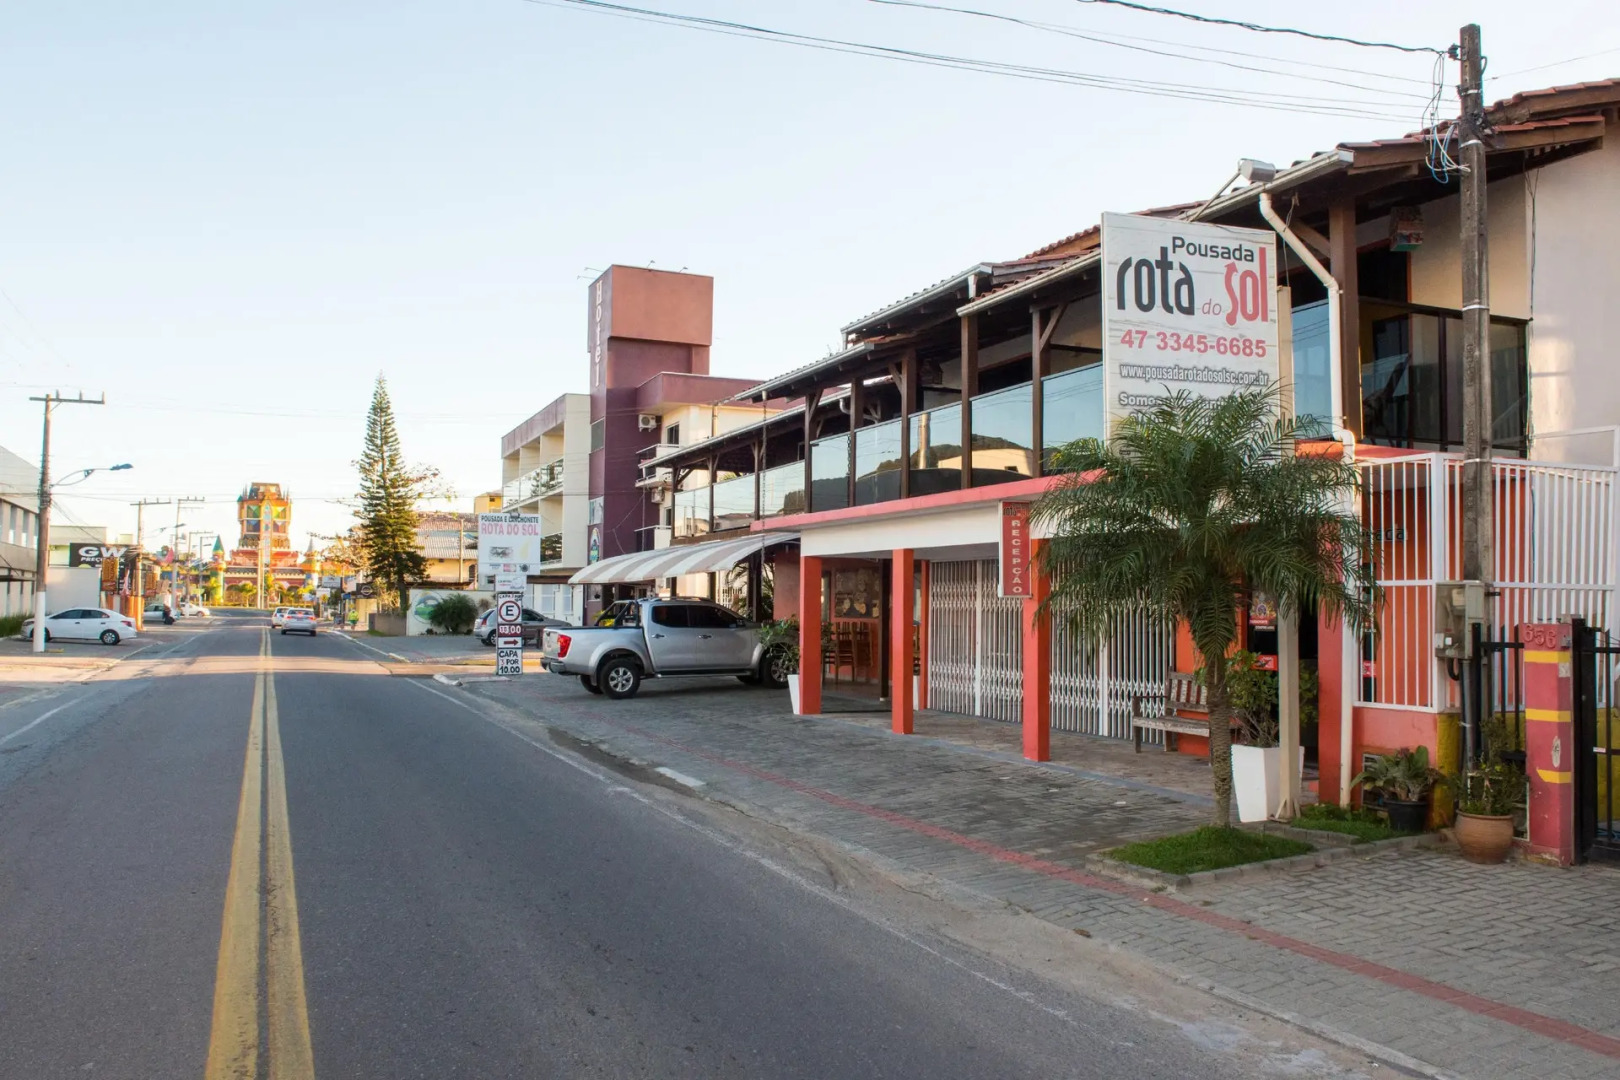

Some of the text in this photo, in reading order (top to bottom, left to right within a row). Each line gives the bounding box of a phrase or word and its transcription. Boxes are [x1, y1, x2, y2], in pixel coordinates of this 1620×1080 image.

[1172, 236, 1254, 262] Pousada
[1116, 246, 1269, 326] rota do sol
[1120, 329, 1267, 358] 47 3345-6685
[1119, 363, 1269, 387] www.pousadarotadosolsc.com.br
[481, 523, 539, 536] ROTA DO SOL
[79, 546, 127, 557] GW
[506, 605, 514, 616] E
[499, 650, 518, 658] CAPA
